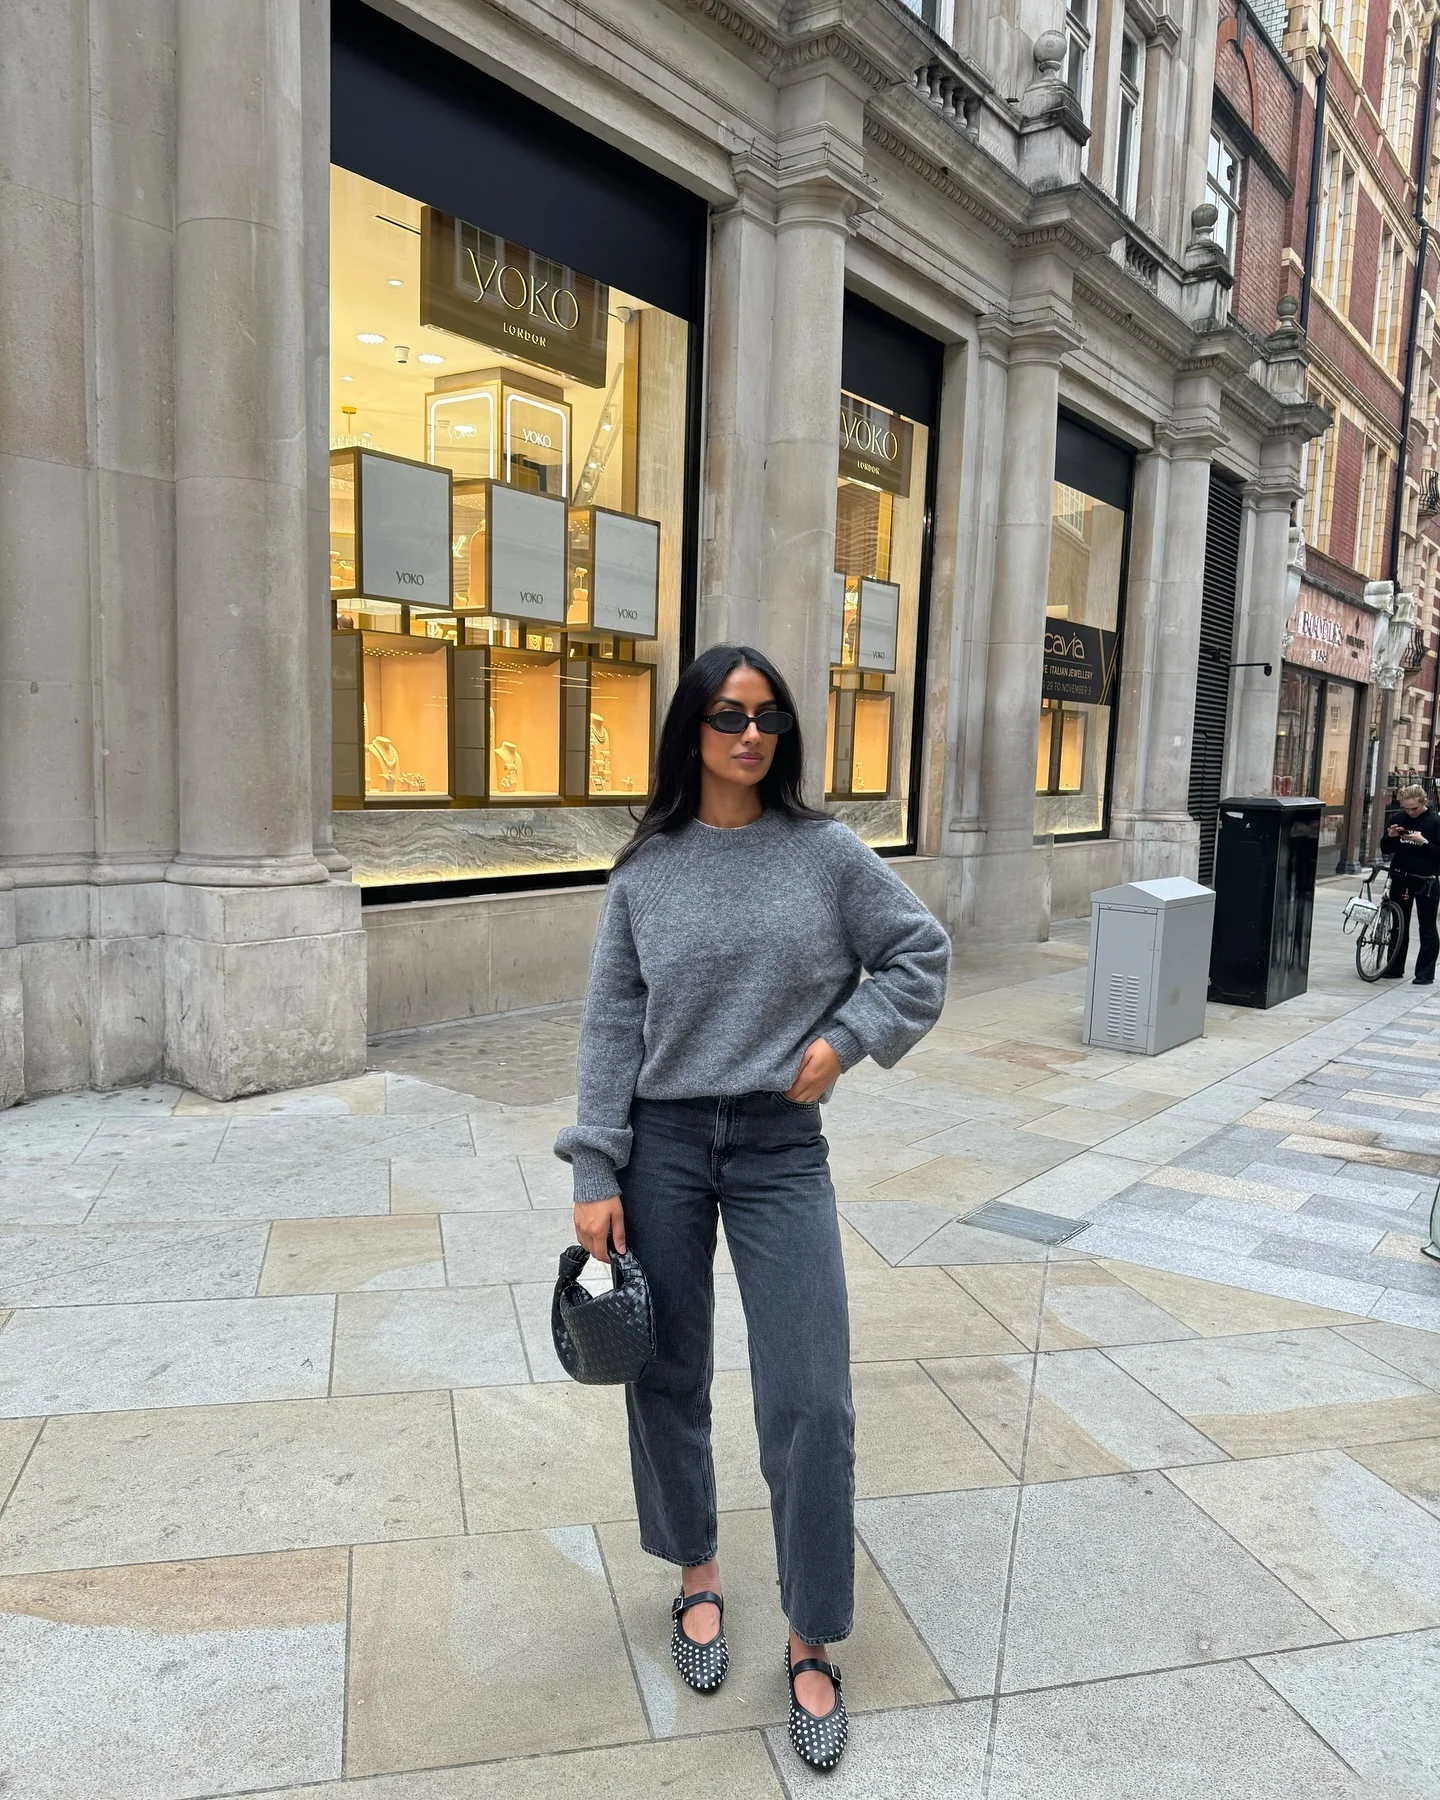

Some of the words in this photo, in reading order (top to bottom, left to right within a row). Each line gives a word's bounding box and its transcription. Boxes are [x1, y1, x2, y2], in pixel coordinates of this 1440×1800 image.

[467, 247, 579, 331] YOKO
[503, 322, 547, 348] LONDON
[522, 428, 552, 448] YOKO
[841, 411, 899, 461] YOKO
[395, 570, 425, 586] YOKO
[519, 590, 544, 605] YOKO
[617, 607, 638, 621] YOKO
[1050, 665, 1068, 677] ITALIAN
[1068, 668, 1093, 680] JEWELLERY
[500, 823, 534, 842] YOKO
